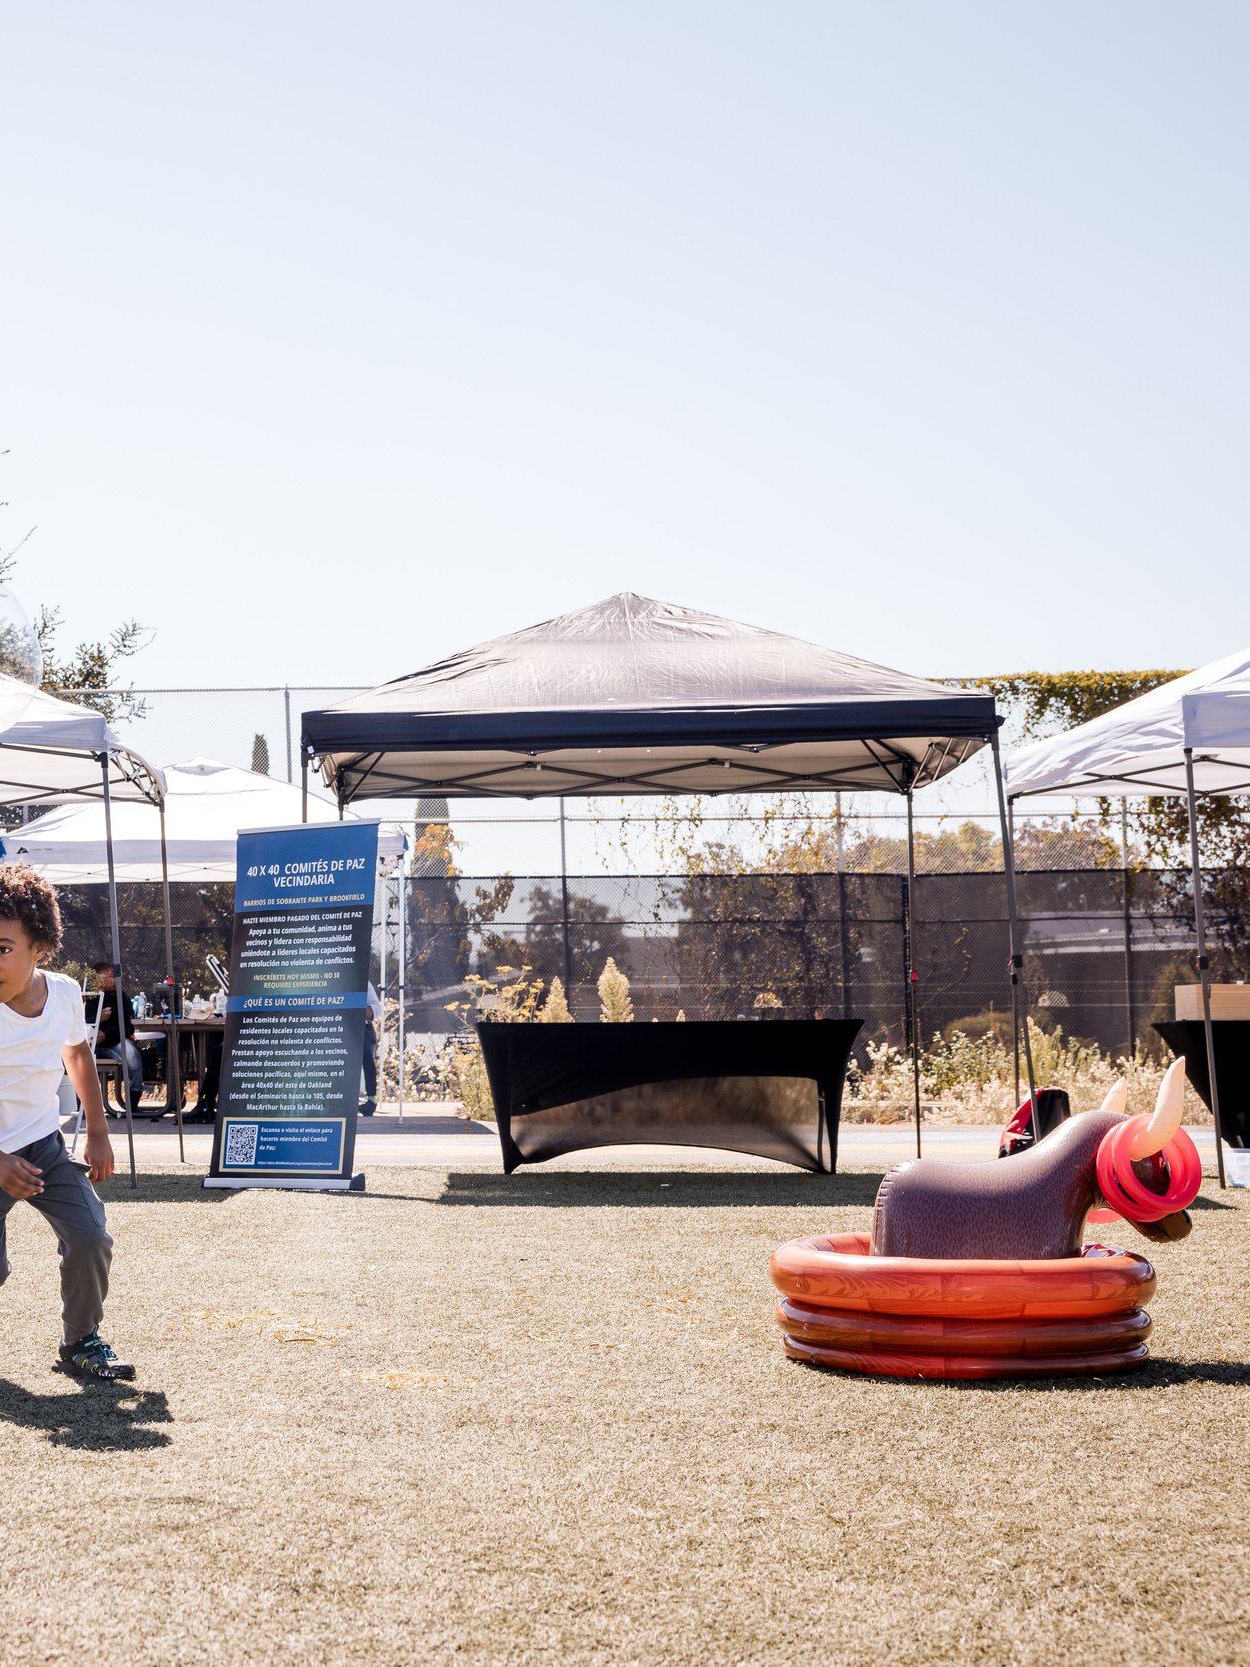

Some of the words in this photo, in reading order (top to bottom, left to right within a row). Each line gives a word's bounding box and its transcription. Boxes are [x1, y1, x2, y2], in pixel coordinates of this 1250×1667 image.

[247, 866, 257, 876] 40
[259, 865, 266, 875] X
[268, 864, 279, 875] 40
[285, 859, 328, 874] COMITÉS
[331, 860, 344, 871] DE
[346, 858, 365, 869] PAZ
[273, 874, 334, 887] VECINDARIA
[322, 912, 342, 920] COMITÉ
[249, 929, 266, 937] Apoya
[281, 925, 317, 934] comunidad,
[305, 934, 351, 944] responsabilidad
[241, 949, 271, 957] uniéndote
[277, 948, 298, 956] líderes
[299, 947, 320, 955] locales
[320, 945, 356, 956] capacitados
[244, 997, 262, 1007] ¿QUÉ
[287, 995, 314, 1005] COMITÉ
[317, 996, 326, 1005] DE
[327, 996, 344, 1005] PAZ?
[311, 1015, 334, 1023] equipos
[294, 1026, 328, 1035] capacitados
[306, 1059, 345, 1068] promoviendo
